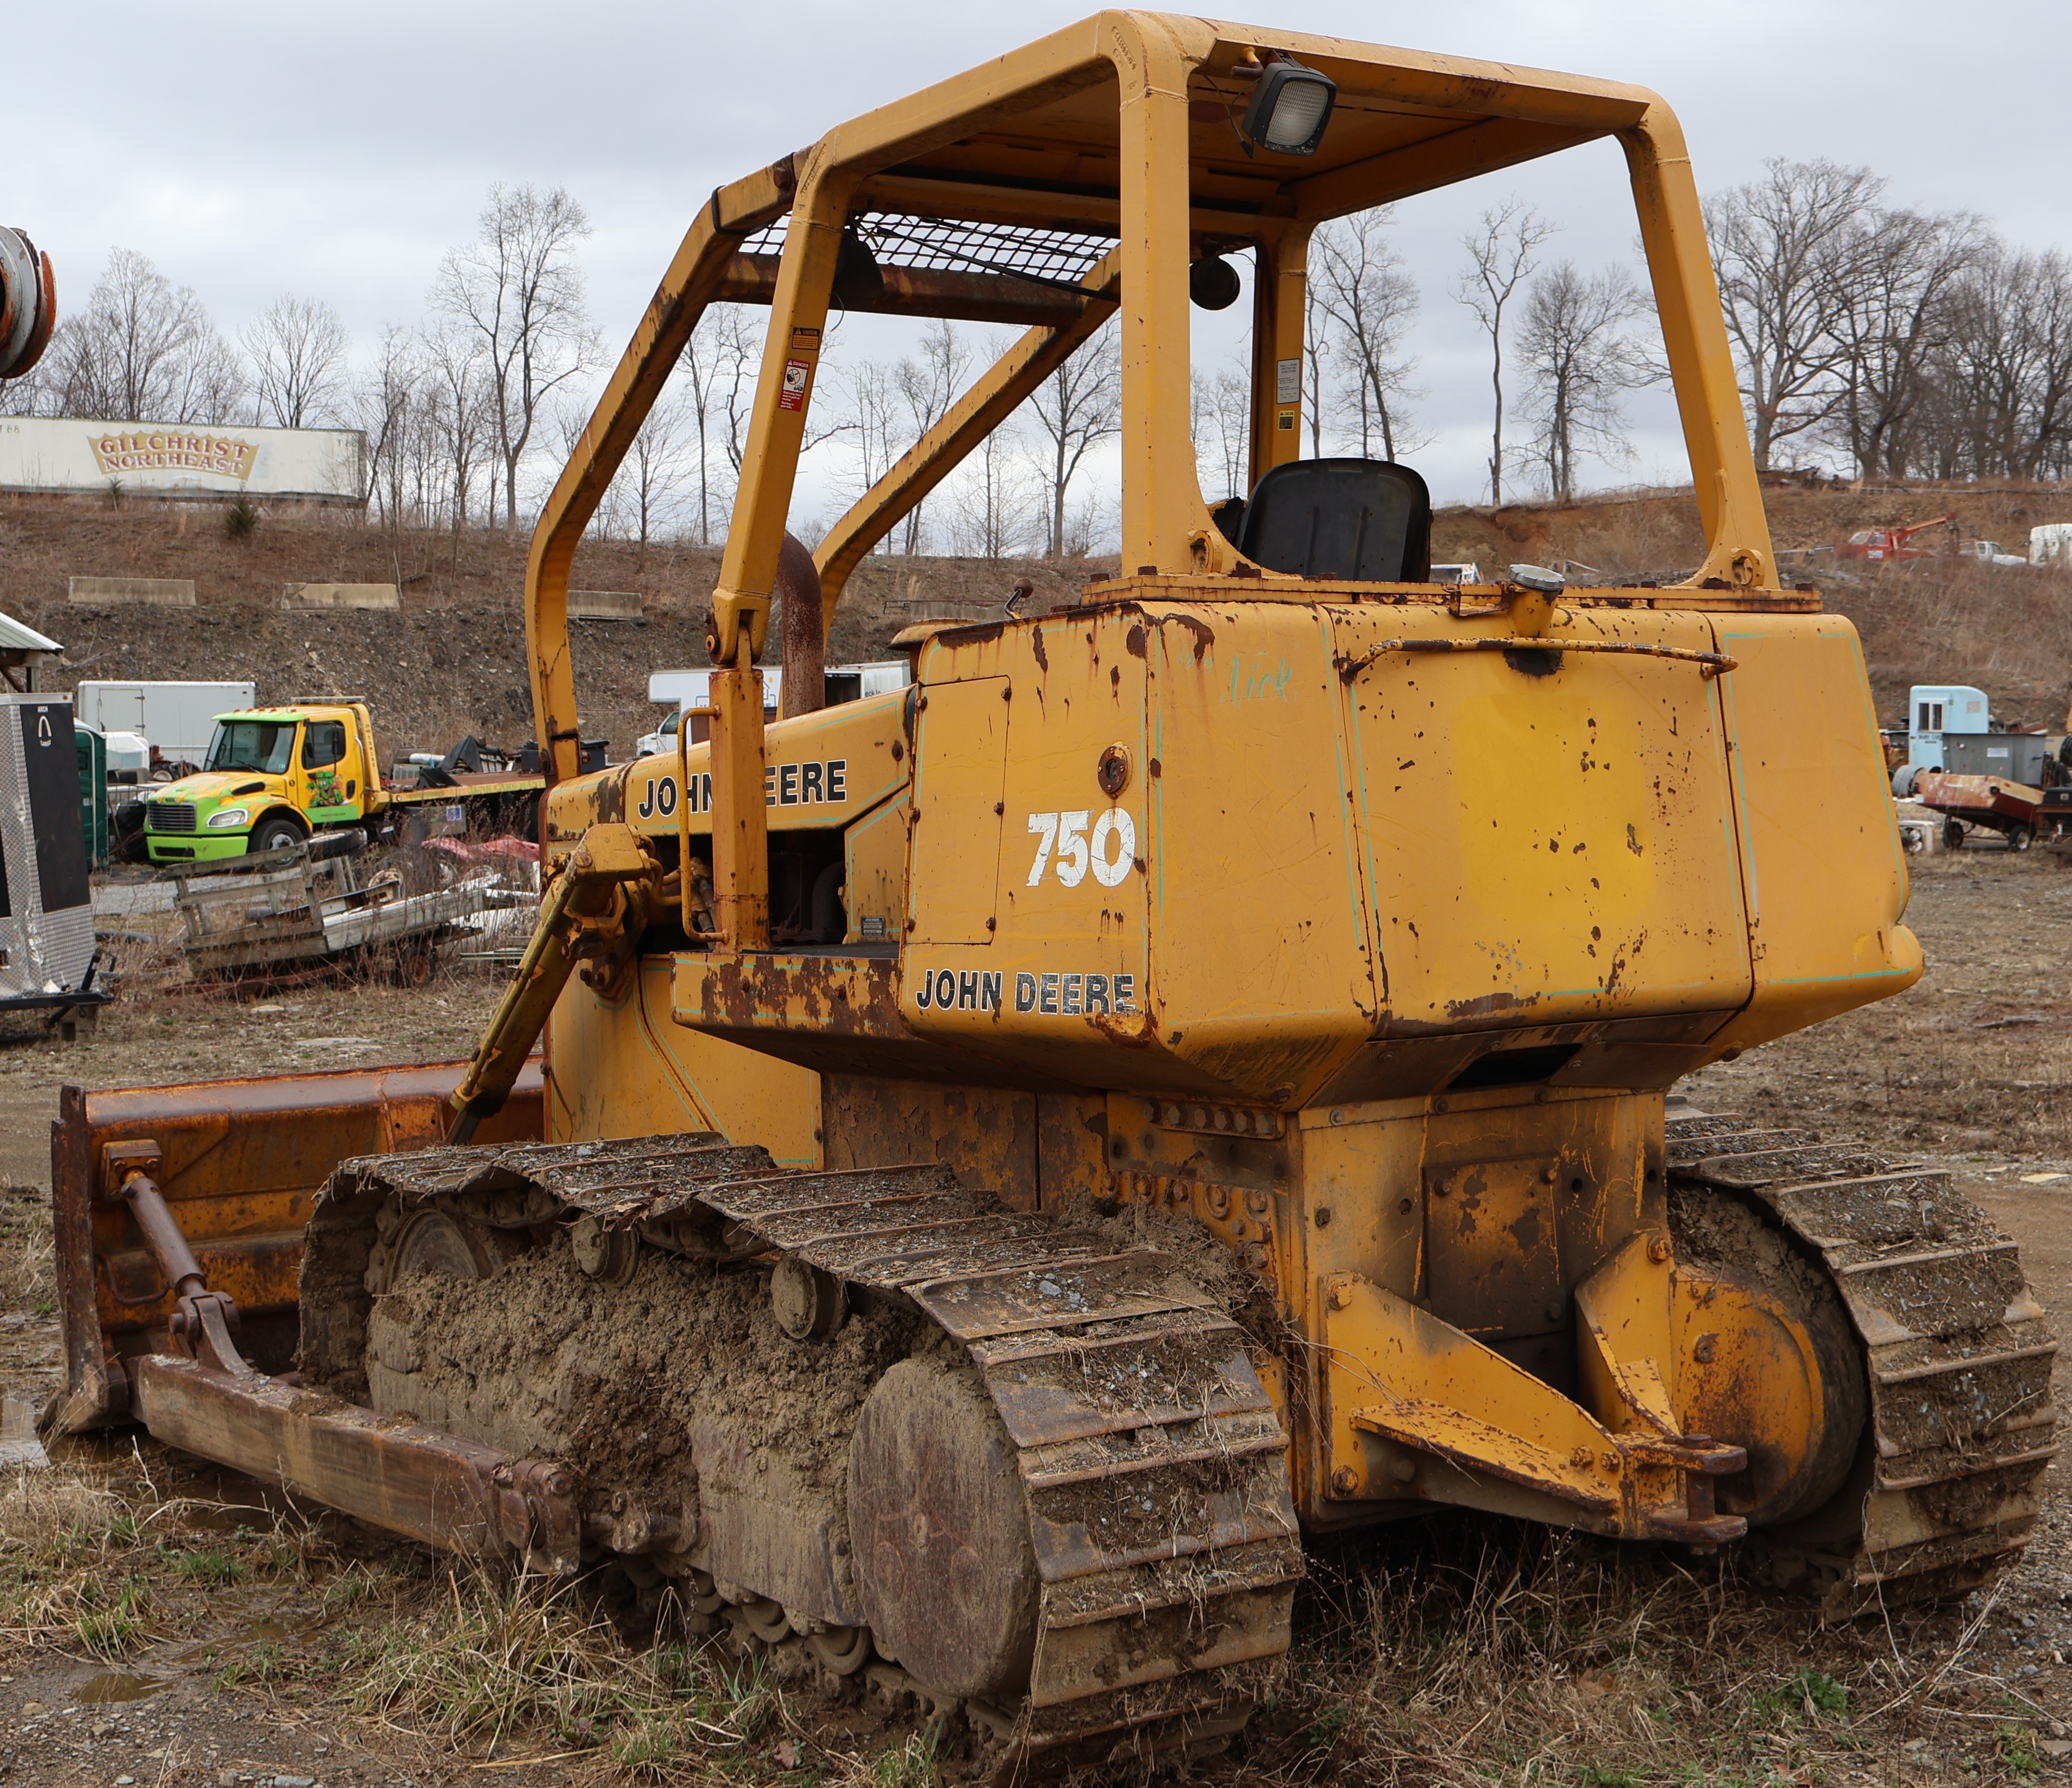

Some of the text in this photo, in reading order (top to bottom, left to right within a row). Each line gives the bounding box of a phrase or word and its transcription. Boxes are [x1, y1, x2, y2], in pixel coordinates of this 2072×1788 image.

[98, 436, 248, 461] GILCHRIST
[103, 453, 243, 475] NORTHEAST
[766, 759, 847, 807] EERE
[1026, 807, 1135, 887] 750
[916, 969, 1137, 1016] JOHN DEERE
